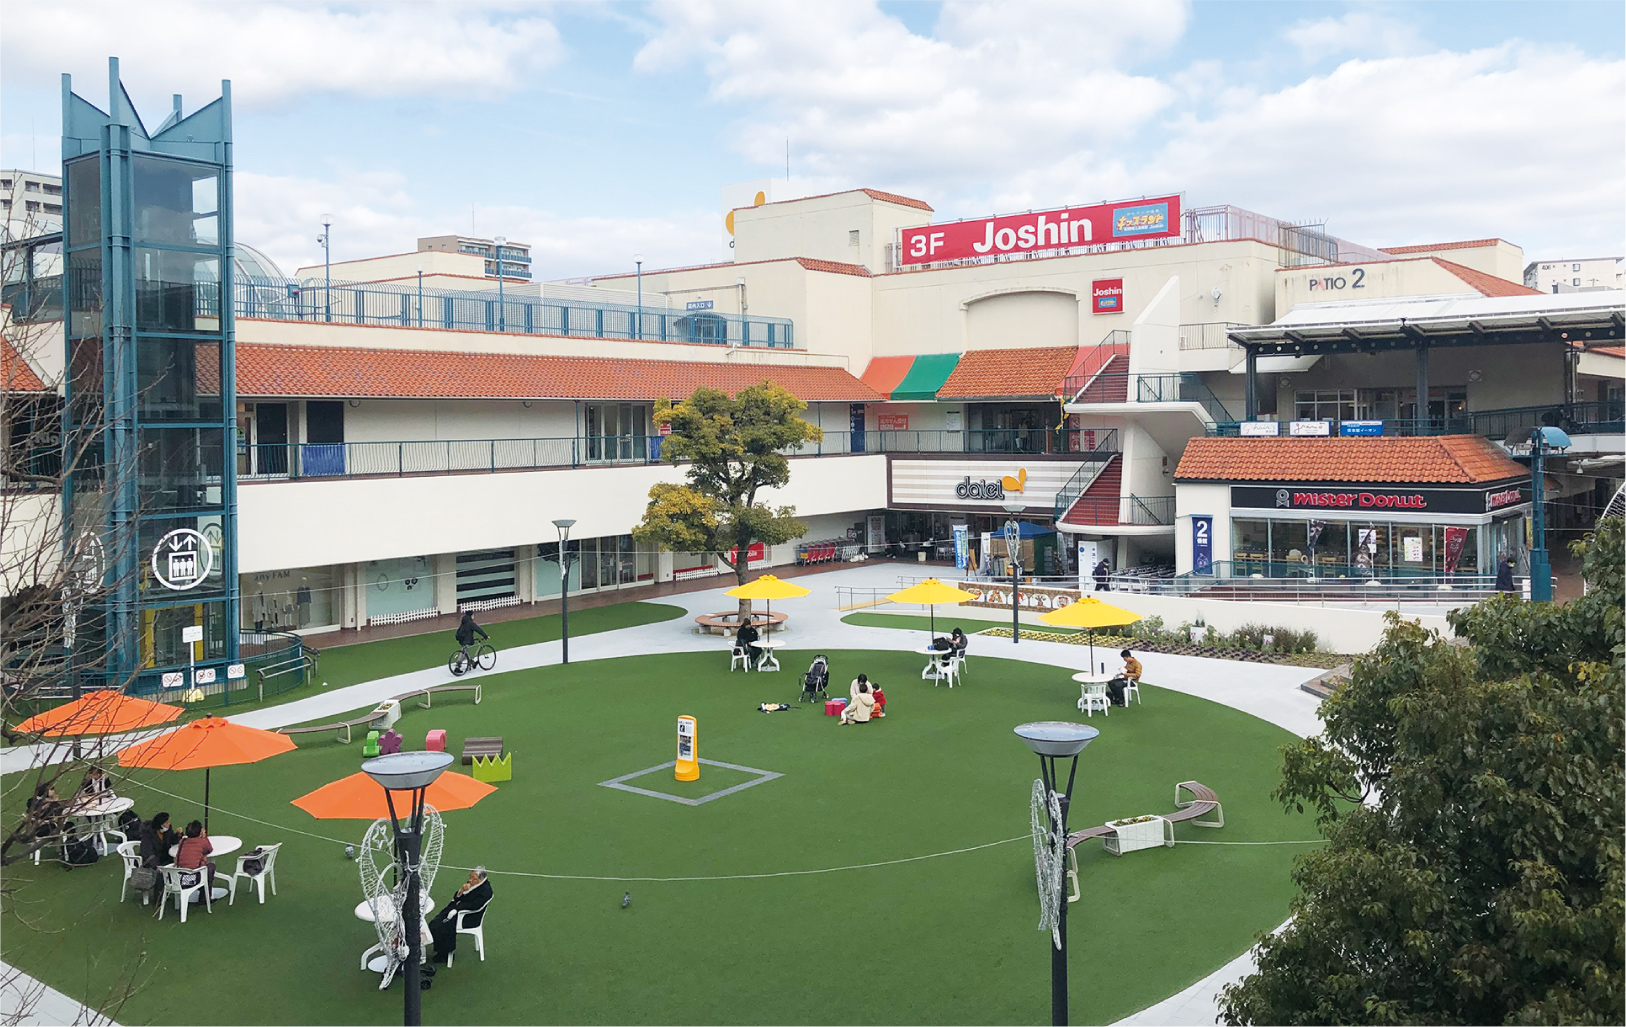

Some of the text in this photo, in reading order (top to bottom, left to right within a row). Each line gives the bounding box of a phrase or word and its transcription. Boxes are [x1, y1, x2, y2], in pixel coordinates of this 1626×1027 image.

[910, 213, 1093, 257] 3F Joshin
[1309, 267, 1365, 291] PATIO 2
[1093, 287, 1122, 296] Joshin
[955, 475, 1005, 500] daiei
[1358, 492, 1427, 508] Donut
[1196, 520, 1208, 538] 2
